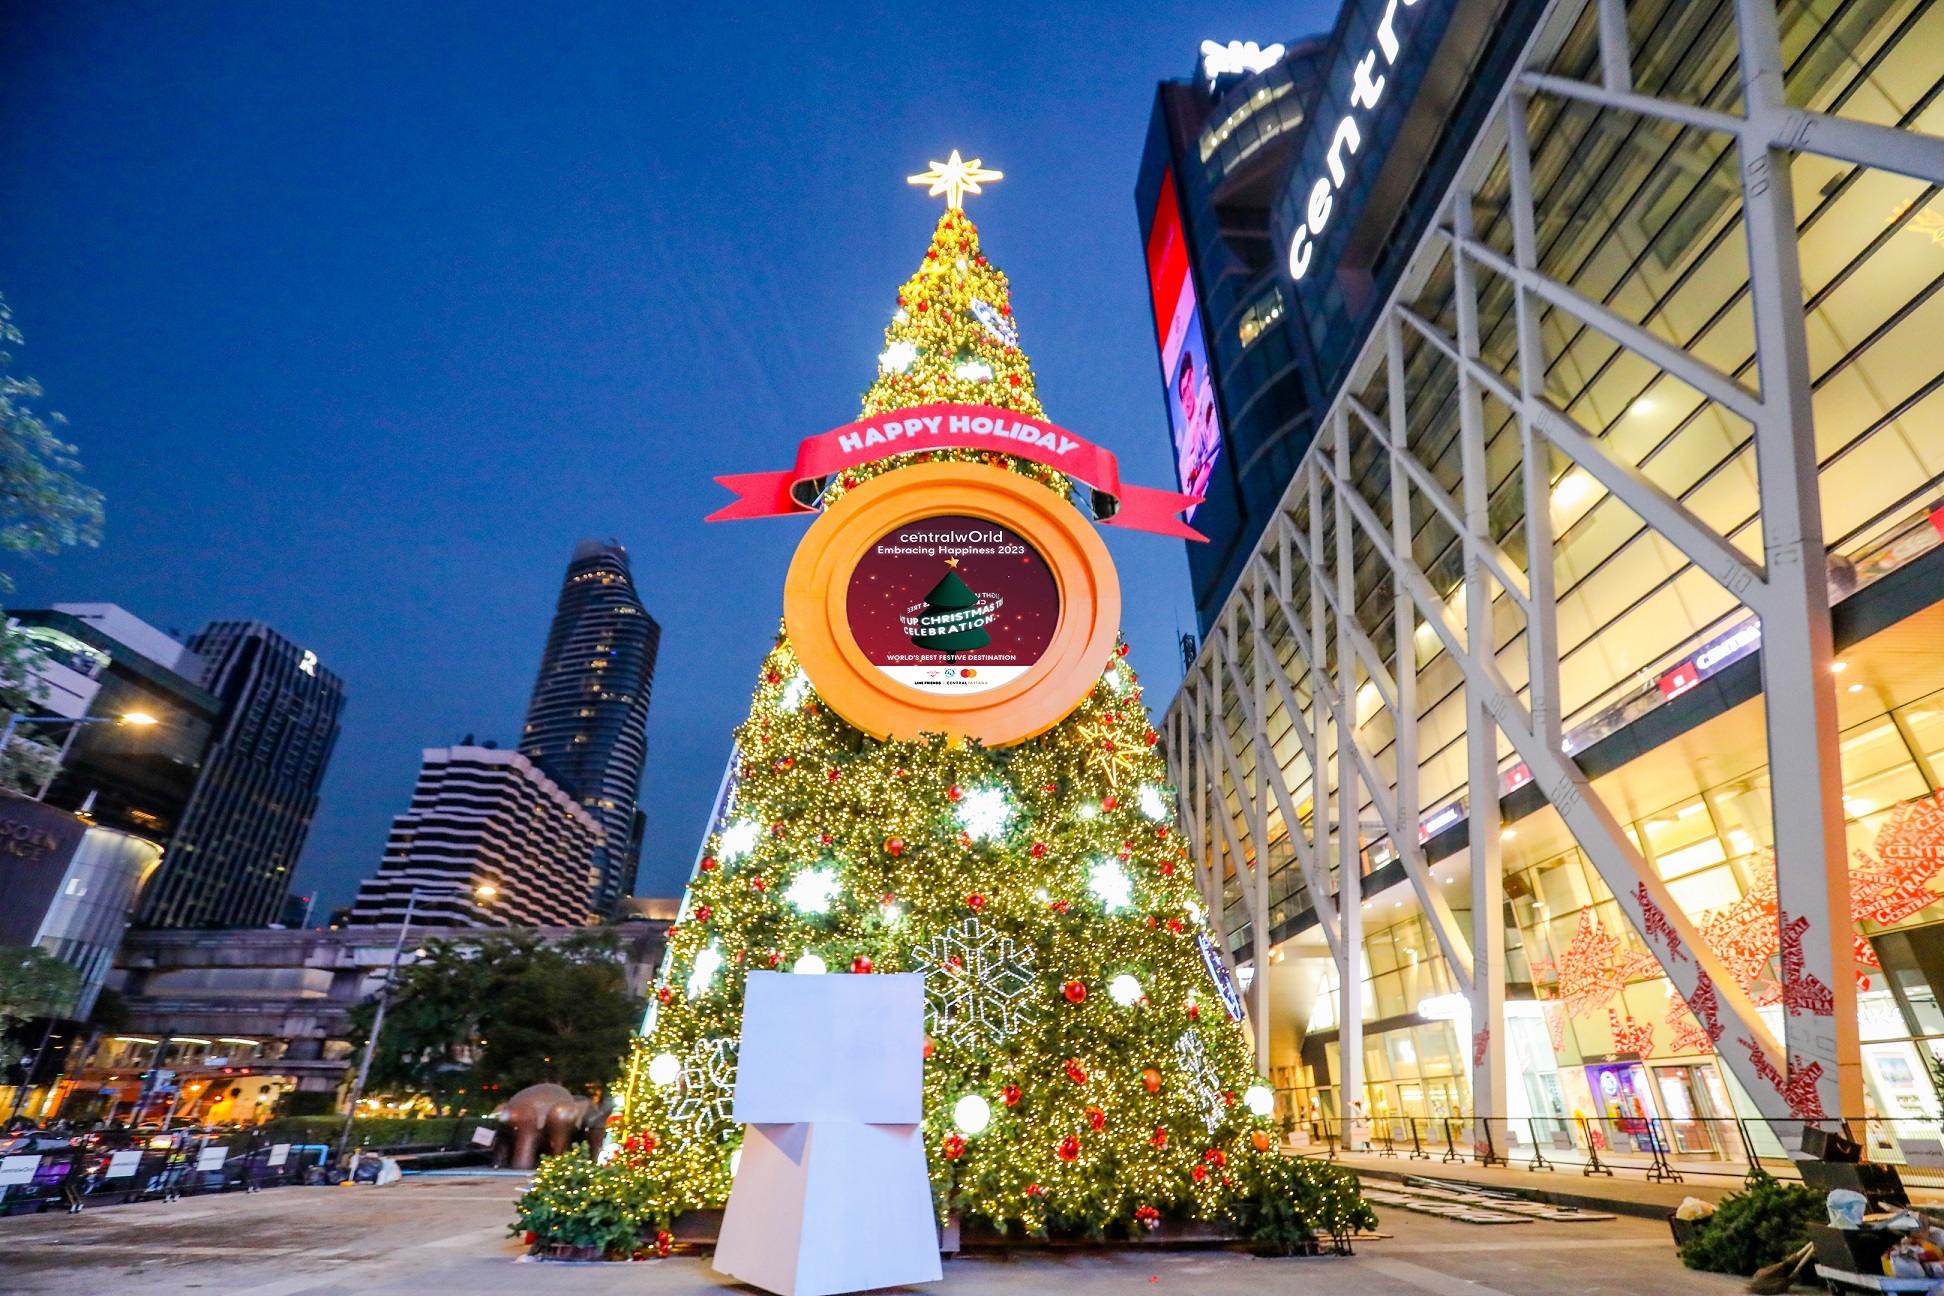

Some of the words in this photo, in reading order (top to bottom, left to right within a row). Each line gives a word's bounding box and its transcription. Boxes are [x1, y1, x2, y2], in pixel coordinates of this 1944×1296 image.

[1289, 0, 1418, 281] centr
[838, 415, 942, 453] HAPPY
[949, 415, 1080, 456] HOLIDAY
[900, 531, 1003, 543] centralwOrld
[877, 545, 935, 556] Embracing
[938, 545, 995, 556] Happiness
[998, 545, 1025, 555] 2023
[903, 614, 997, 637] CELEBRATION.
[906, 617, 919, 626] UP
[921, 603, 995, 626] CHRISTMAS
